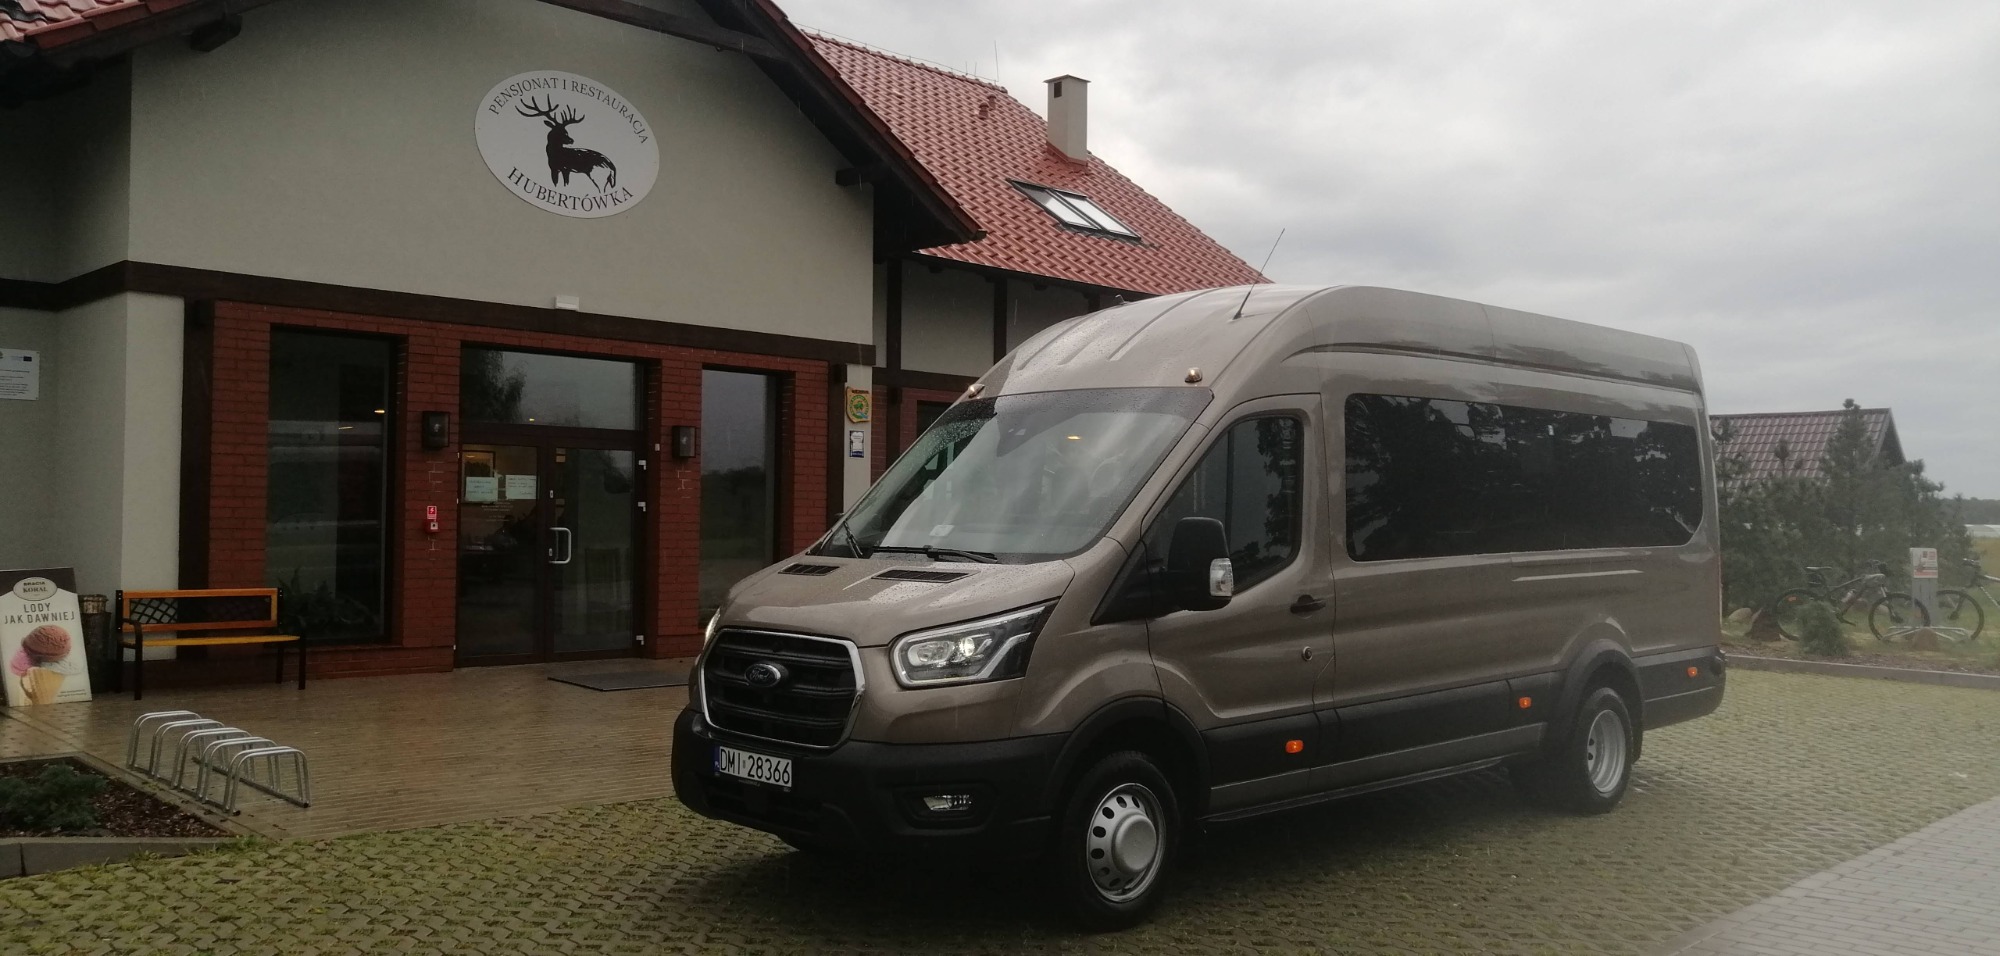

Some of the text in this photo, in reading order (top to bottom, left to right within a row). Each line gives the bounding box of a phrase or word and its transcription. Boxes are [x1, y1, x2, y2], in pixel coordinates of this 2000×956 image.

[488, 77, 649, 144] PENSJONAT I RESTAURACJA
[506, 166, 634, 212] HUBERTÓWKA
[4, 611, 75, 624] JAK DAWNIEJ
[23, 602, 51, 613] LODY
[720, 748, 791, 785] DMI 28366
